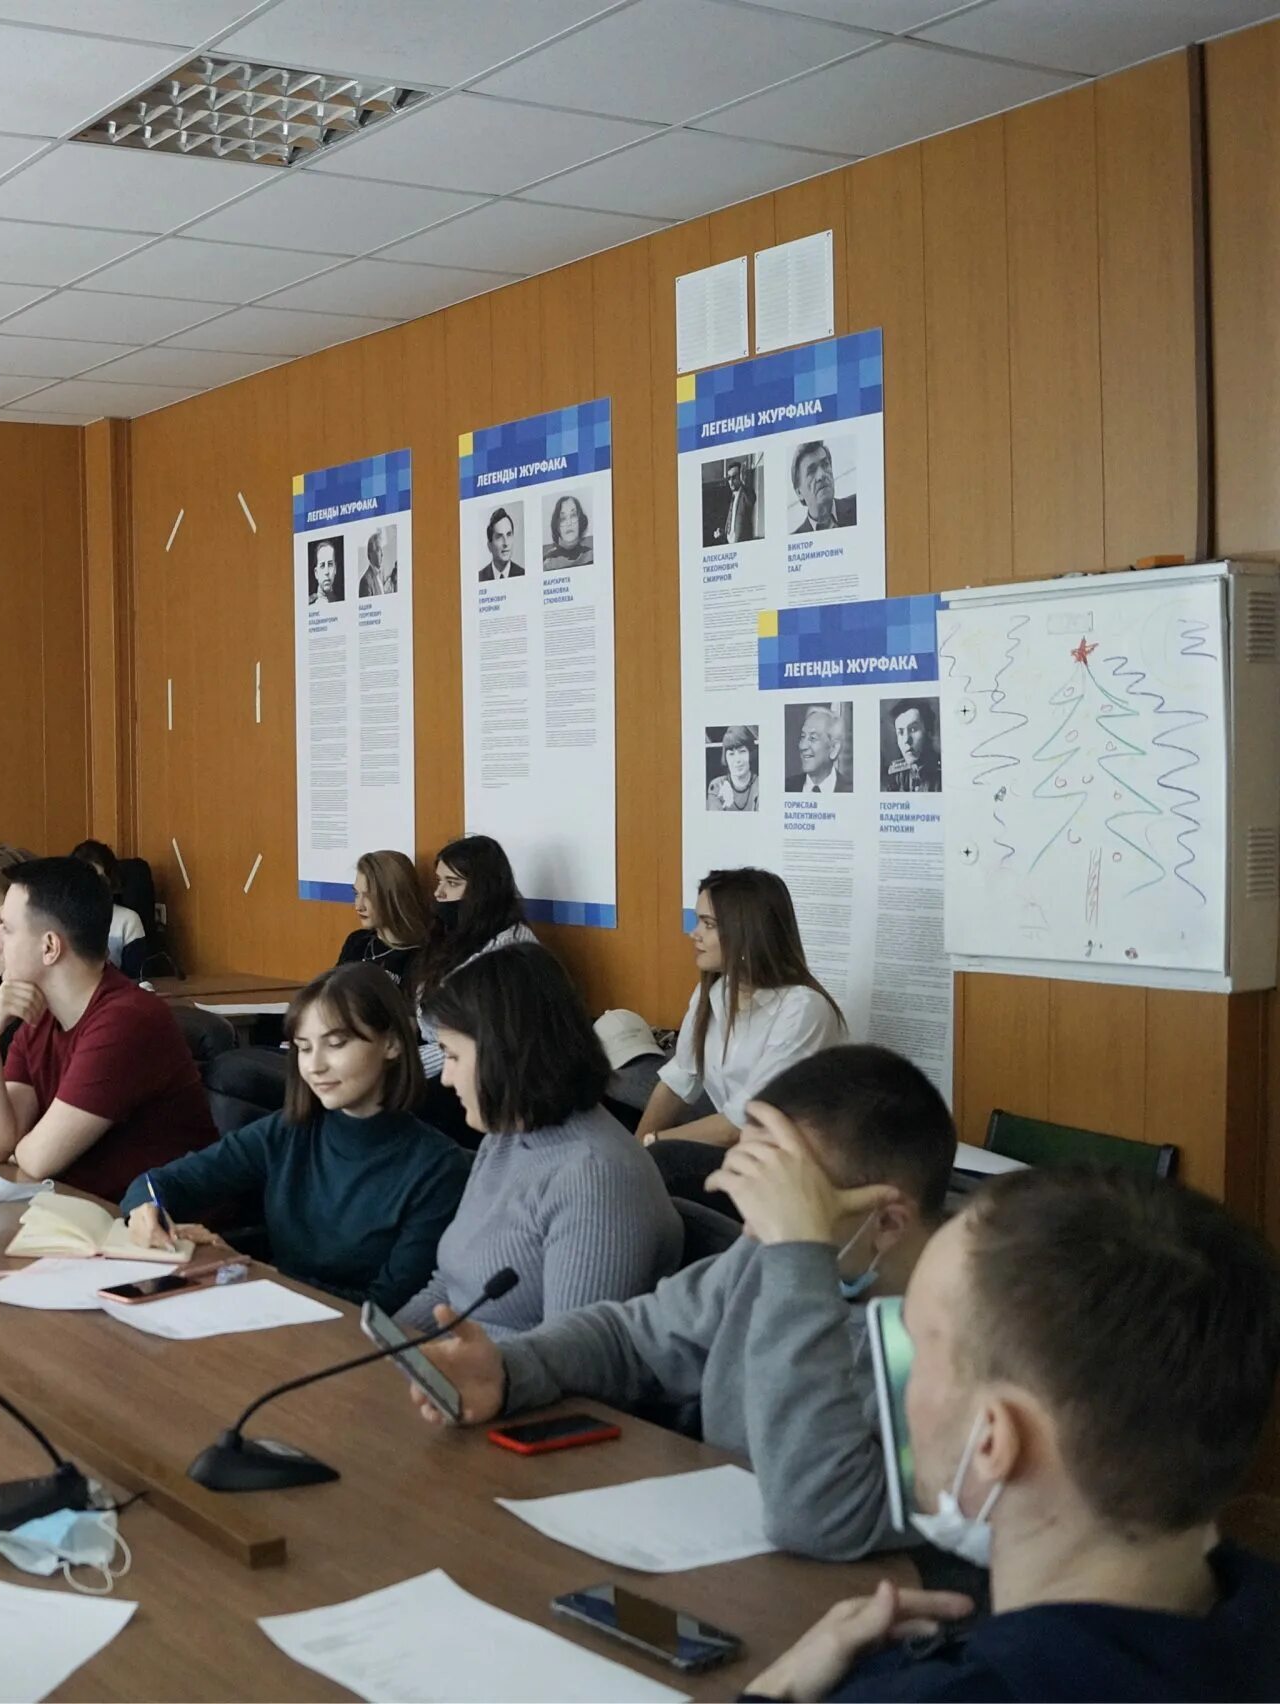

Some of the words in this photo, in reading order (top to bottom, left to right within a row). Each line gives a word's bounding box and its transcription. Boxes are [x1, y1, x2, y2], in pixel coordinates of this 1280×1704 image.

[701, 413, 755, 438] ЛЕГЕНДЫ
[757, 399, 823, 426] ЖУРФАКА
[476, 467, 518, 488] ЛЕГЕНДЫ
[519, 456, 568, 478] ЖУРФАКА
[307, 505, 339, 523] ЛЕГЕНДЫ
[340, 497, 378, 516] ЖУРФАКА
[787, 541, 813, 552] ВИКТОР
[702, 552, 737, 563] АЛЕКСАНДР
[787, 548, 844, 562] ВЛАДИМИРОВИЧ
[703, 562, 739, 573] ТИХОНОВИЧ
[703, 573, 732, 584] СМИРНОВ
[783, 659, 844, 678] ЛЕГЕНДЫ
[846, 654, 918, 674] ЖУРФАКА
[784, 801, 818, 809] ГОРИСЛАВ
[879, 801, 910, 810] ГЕОРГИЙ
[784, 812, 836, 821] ВАЛЕНТИНОВИЧ
[879, 814, 941, 823] ВЛАДИМИРОВИЧ
[784, 822, 816, 831] КОЛОСОВ
[879, 825, 915, 833] АНТЮХИН
